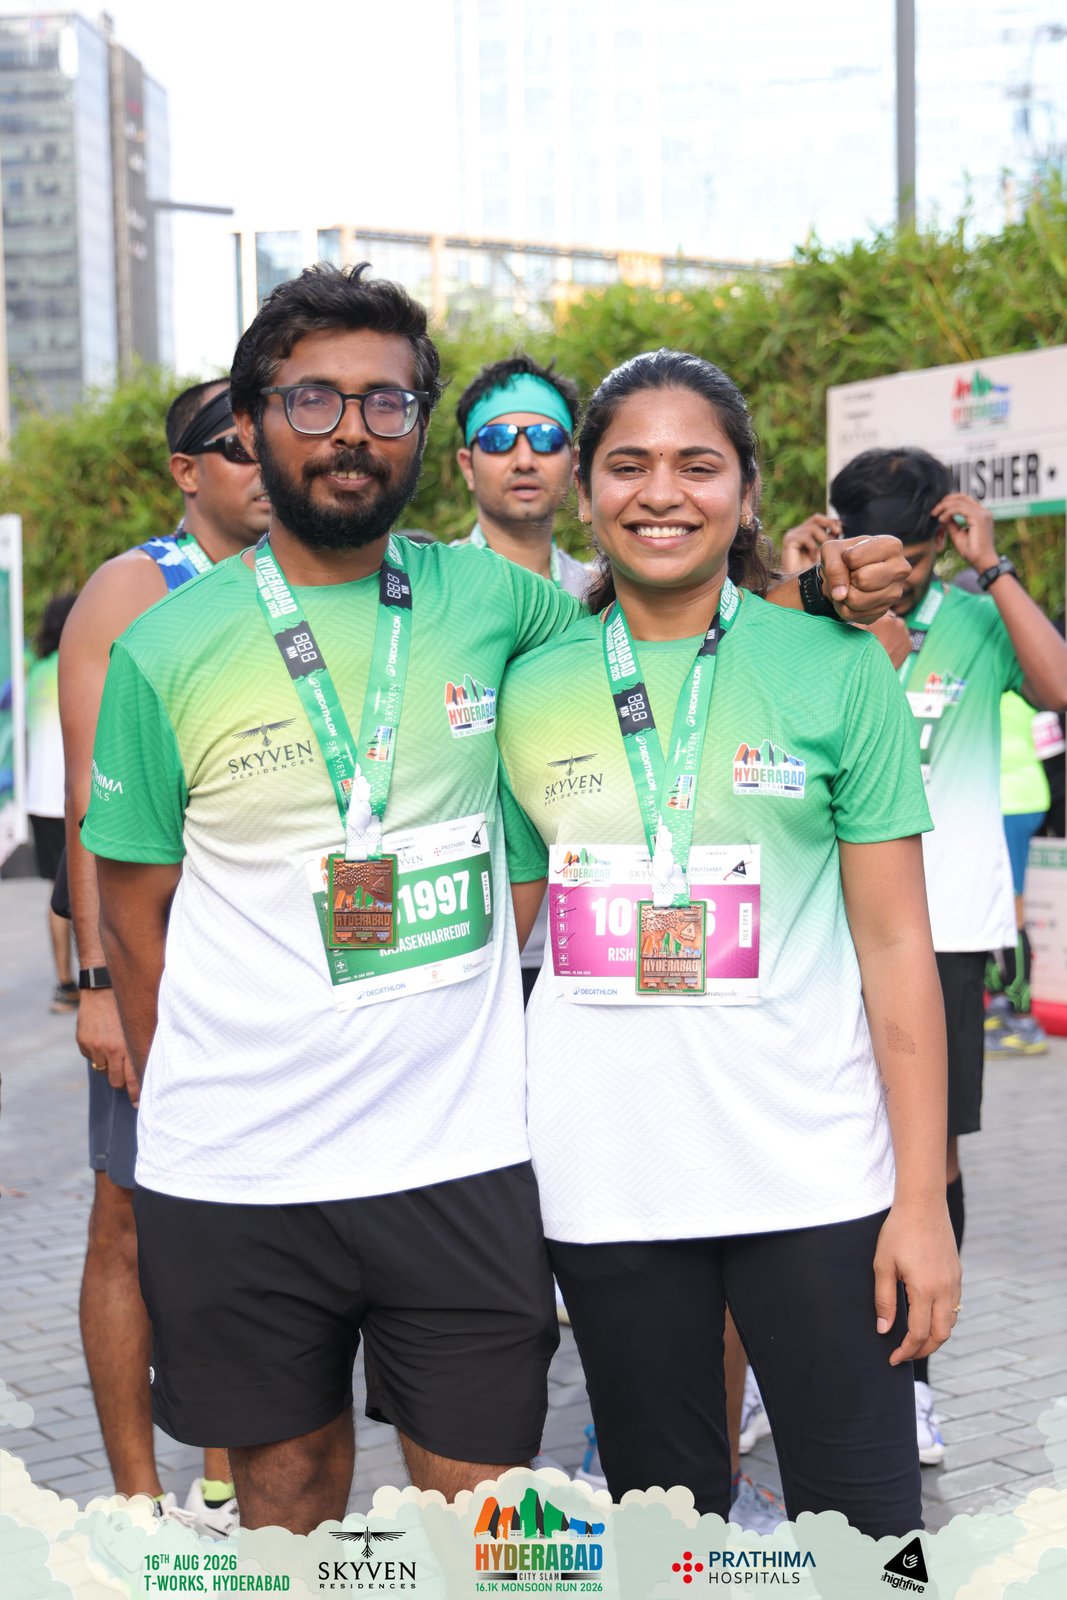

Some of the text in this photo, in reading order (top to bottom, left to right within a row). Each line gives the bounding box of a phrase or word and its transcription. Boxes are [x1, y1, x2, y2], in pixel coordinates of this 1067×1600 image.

[256, 555, 298, 615] HYDERABAD
[285, 645, 299, 660] KM
[387, 615, 402, 664] DECATHLON
[611, 612, 637, 678] HYDERABAD
[384, 683, 399, 722] SKYVEN
[687, 665, 702, 715] DECATHLON
[313, 685, 339, 737] DECATHLON
[619, 705, 631, 718] KM
[228, 740, 312, 774] SKYVEN
[328, 740, 347, 778] SKYVEN
[684, 732, 697, 771] SKYVEN
[231, 758, 314, 780] RESIDENCES
[638, 745, 658, 791] DECATHLON
[734, 767, 805, 786] HYDERABAD
[545, 773, 603, 800] SKYVEN
[400, 854, 424, 868] YVEN
[563, 868, 611, 878] HYDERABAD
[629, 870, 653, 879] SKYV
[397, 869, 470, 925] 1997
[336, 913, 390, 926] HYDERABAD
[643, 959, 698, 972] HYDERABAD
[365, 983, 406, 997] DECATHLON
